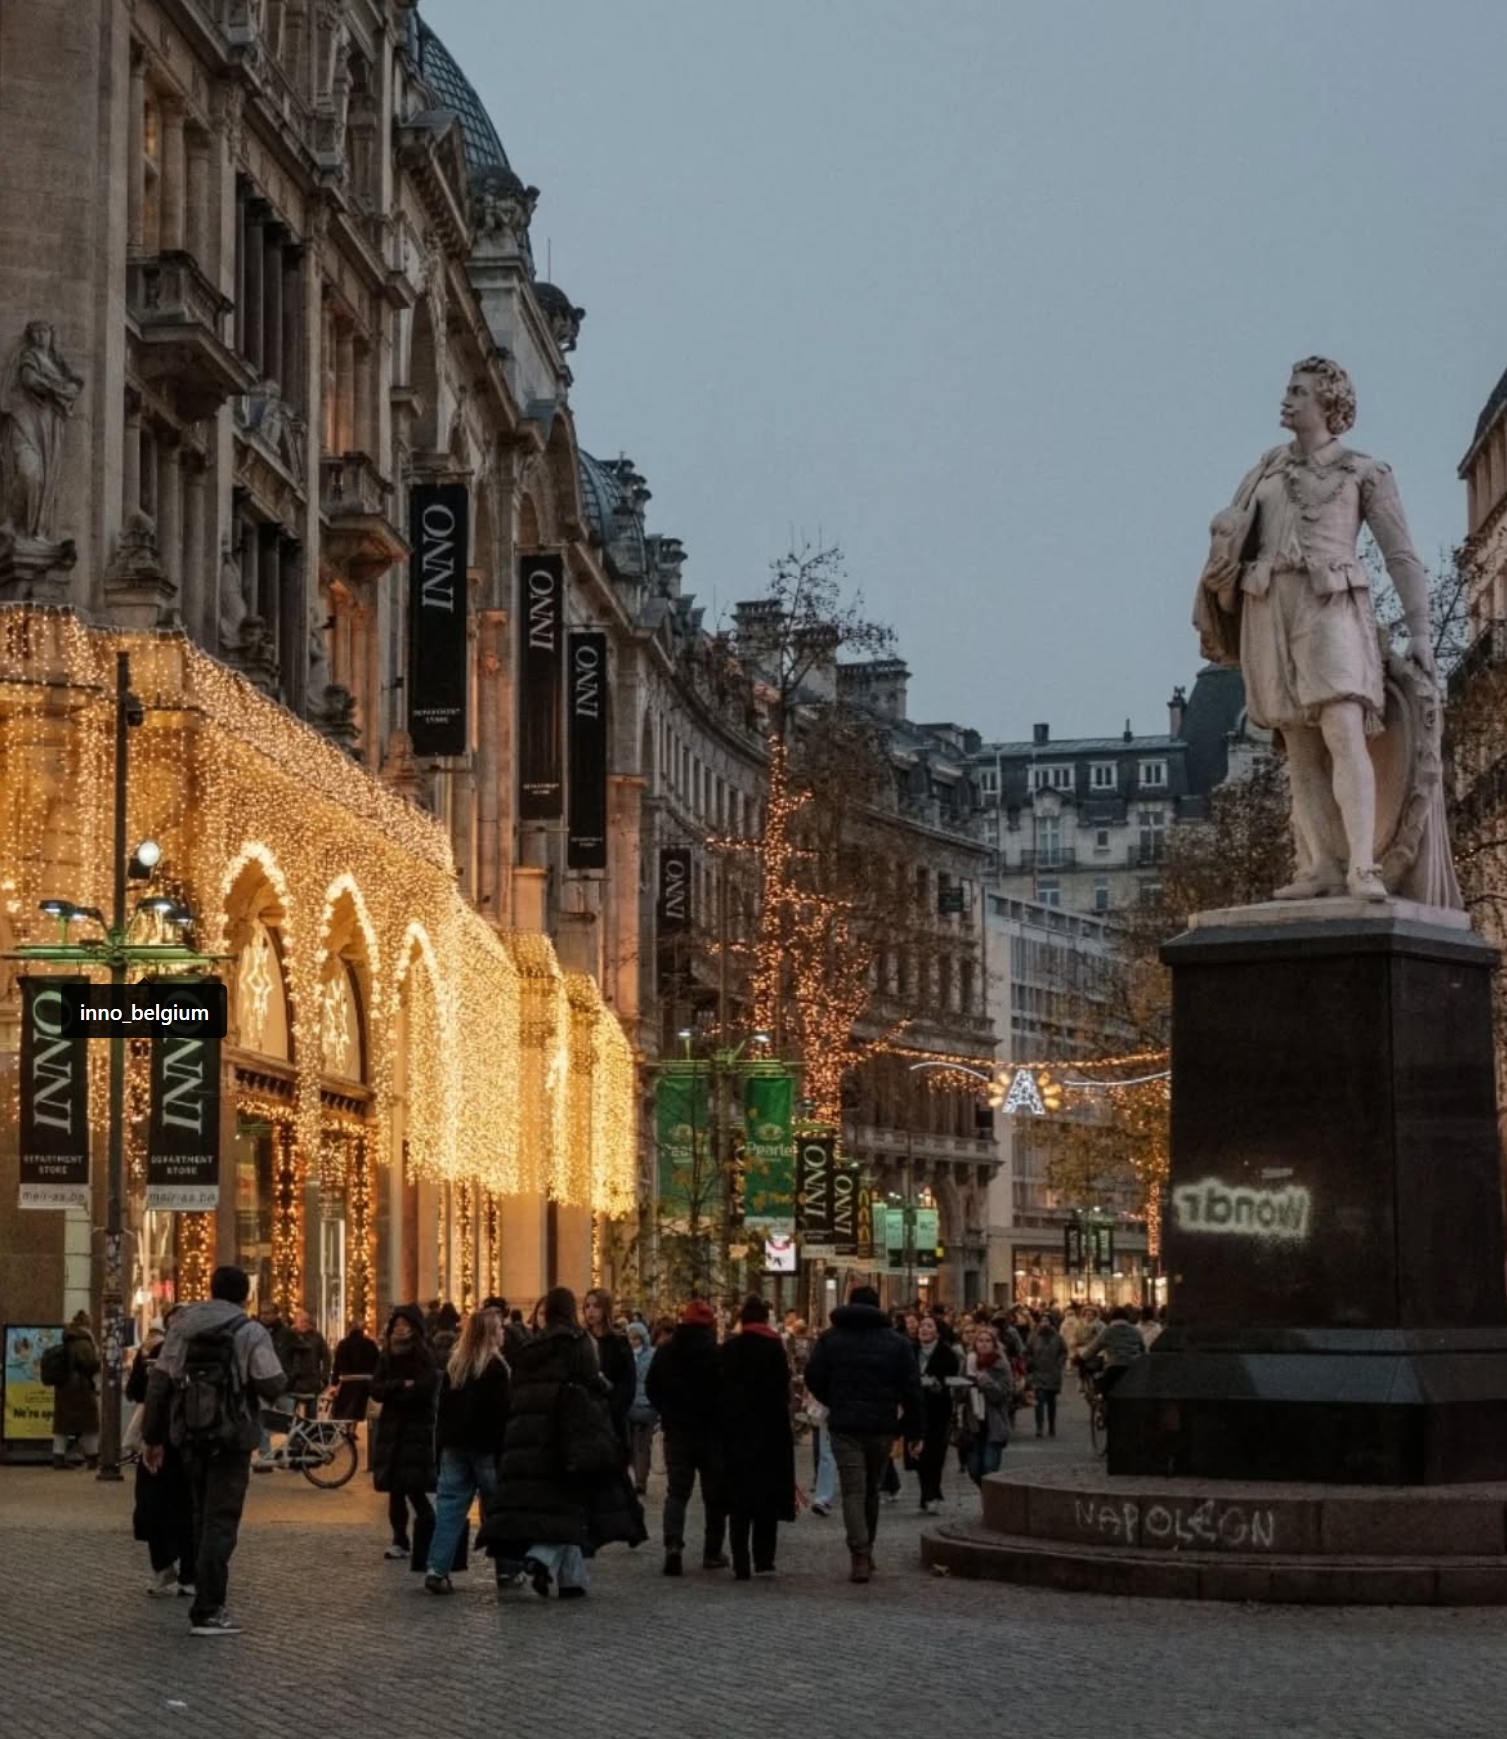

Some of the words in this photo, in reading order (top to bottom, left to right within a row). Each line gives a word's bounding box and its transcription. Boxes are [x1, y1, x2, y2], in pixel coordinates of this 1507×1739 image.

[421, 503, 455, 613] INNO
[528, 568, 555, 651] INNO
[575, 645, 599, 719] INNO
[665, 859, 685, 921] INNO
[38, 1165, 68, 1175] STORE
[151, 1154, 214, 1165] DEPARTMENT
[803, 1145, 828, 1220] INNO
[834, 1174, 854, 1236] INNO
